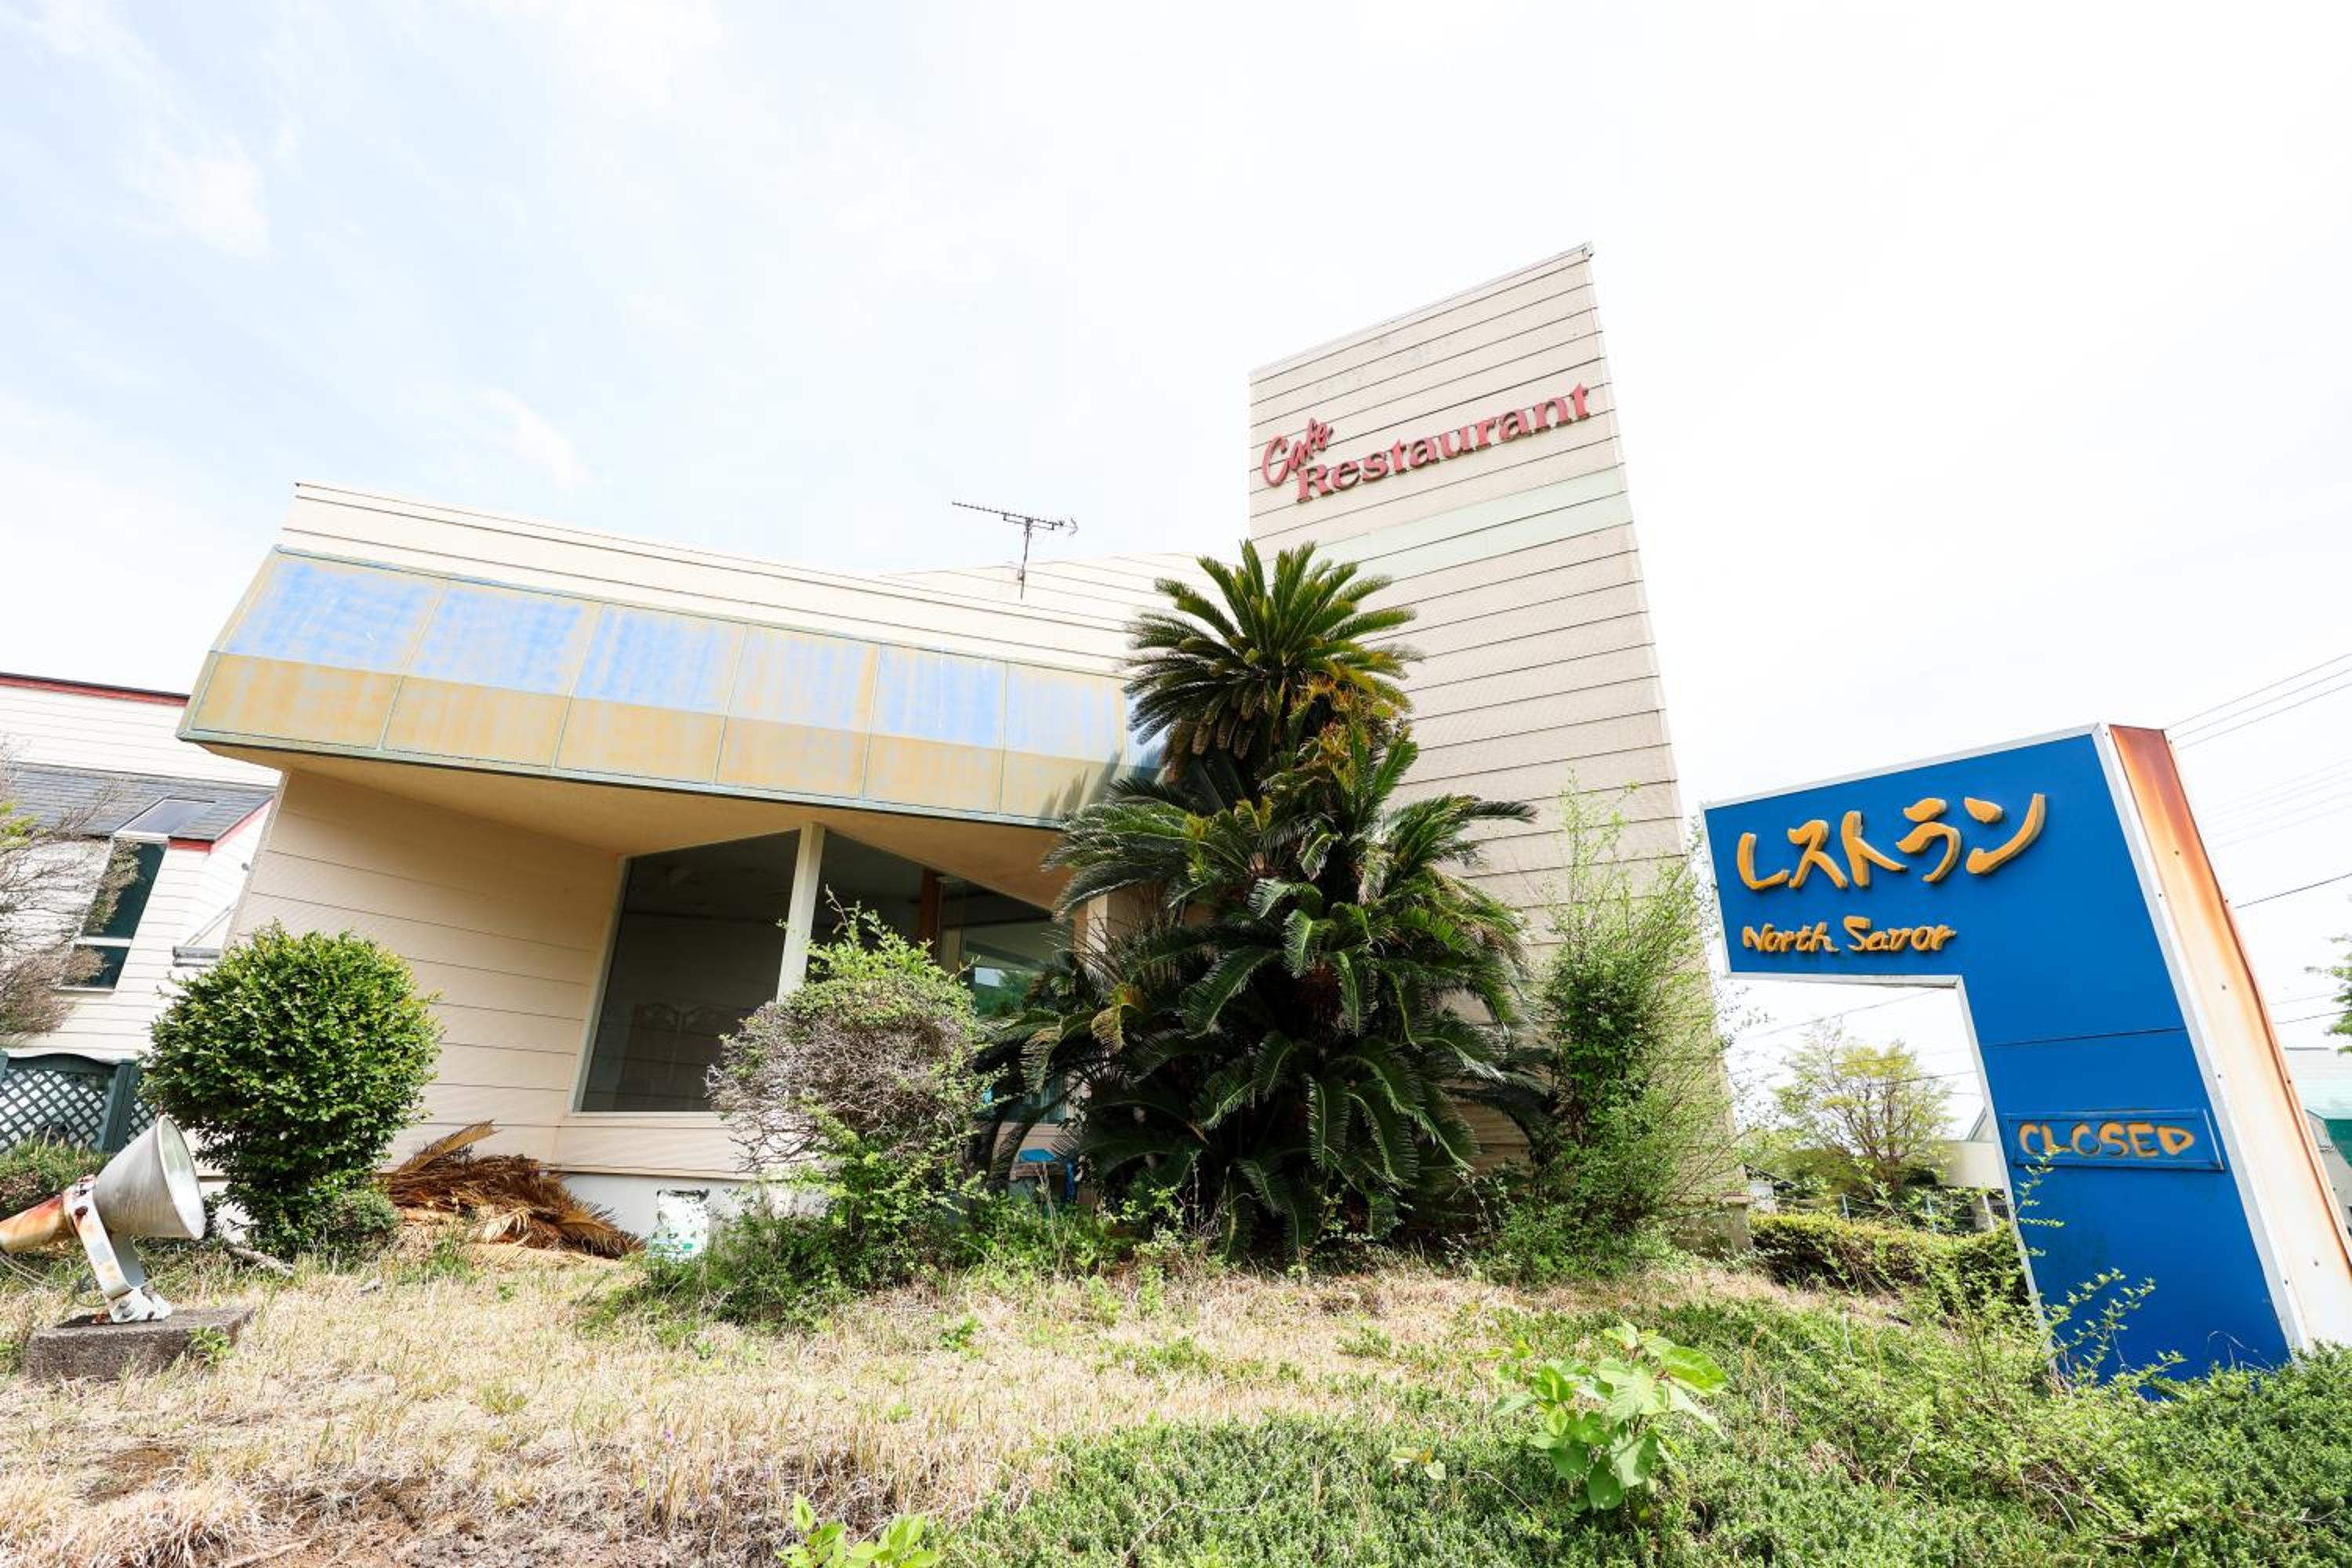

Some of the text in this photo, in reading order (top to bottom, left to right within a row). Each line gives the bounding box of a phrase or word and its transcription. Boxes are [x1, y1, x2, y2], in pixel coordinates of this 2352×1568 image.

[1262, 417, 1334, 487] Cafe
[1296, 383, 1591, 503] Restaurant
[1737, 793, 2045, 891] レストラン
[1742, 915, 1957, 953] North Savor
[2019, 1121, 2195, 1158] CLOSED
